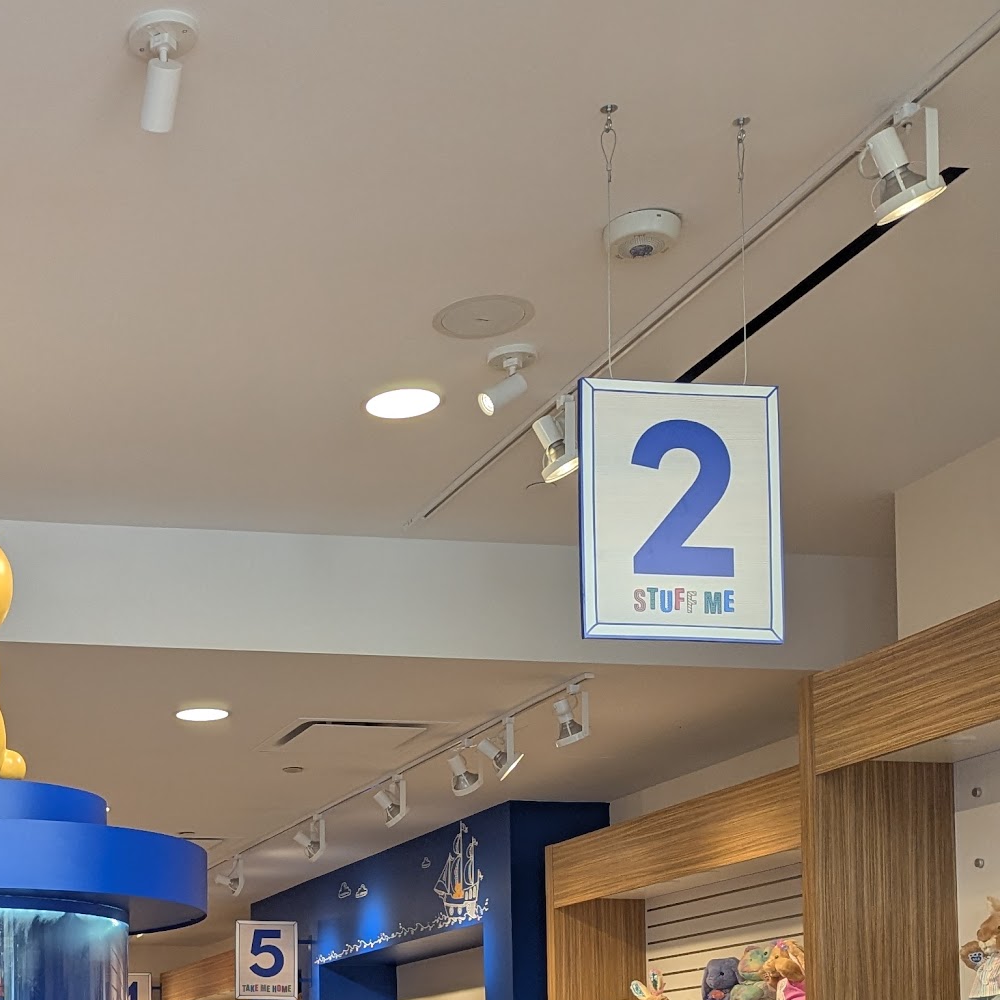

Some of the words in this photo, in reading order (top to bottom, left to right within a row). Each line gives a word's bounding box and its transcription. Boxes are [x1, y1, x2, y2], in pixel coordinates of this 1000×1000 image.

[631, 419, 734, 577] 2
[633, 587, 697, 613] STUFF
[704, 589, 735, 614] ME
[249, 929, 284, 977] 5
[242, 984, 259, 993] TAKE
[260, 984, 271, 993] ME
[272, 984, 292, 993] HOME
